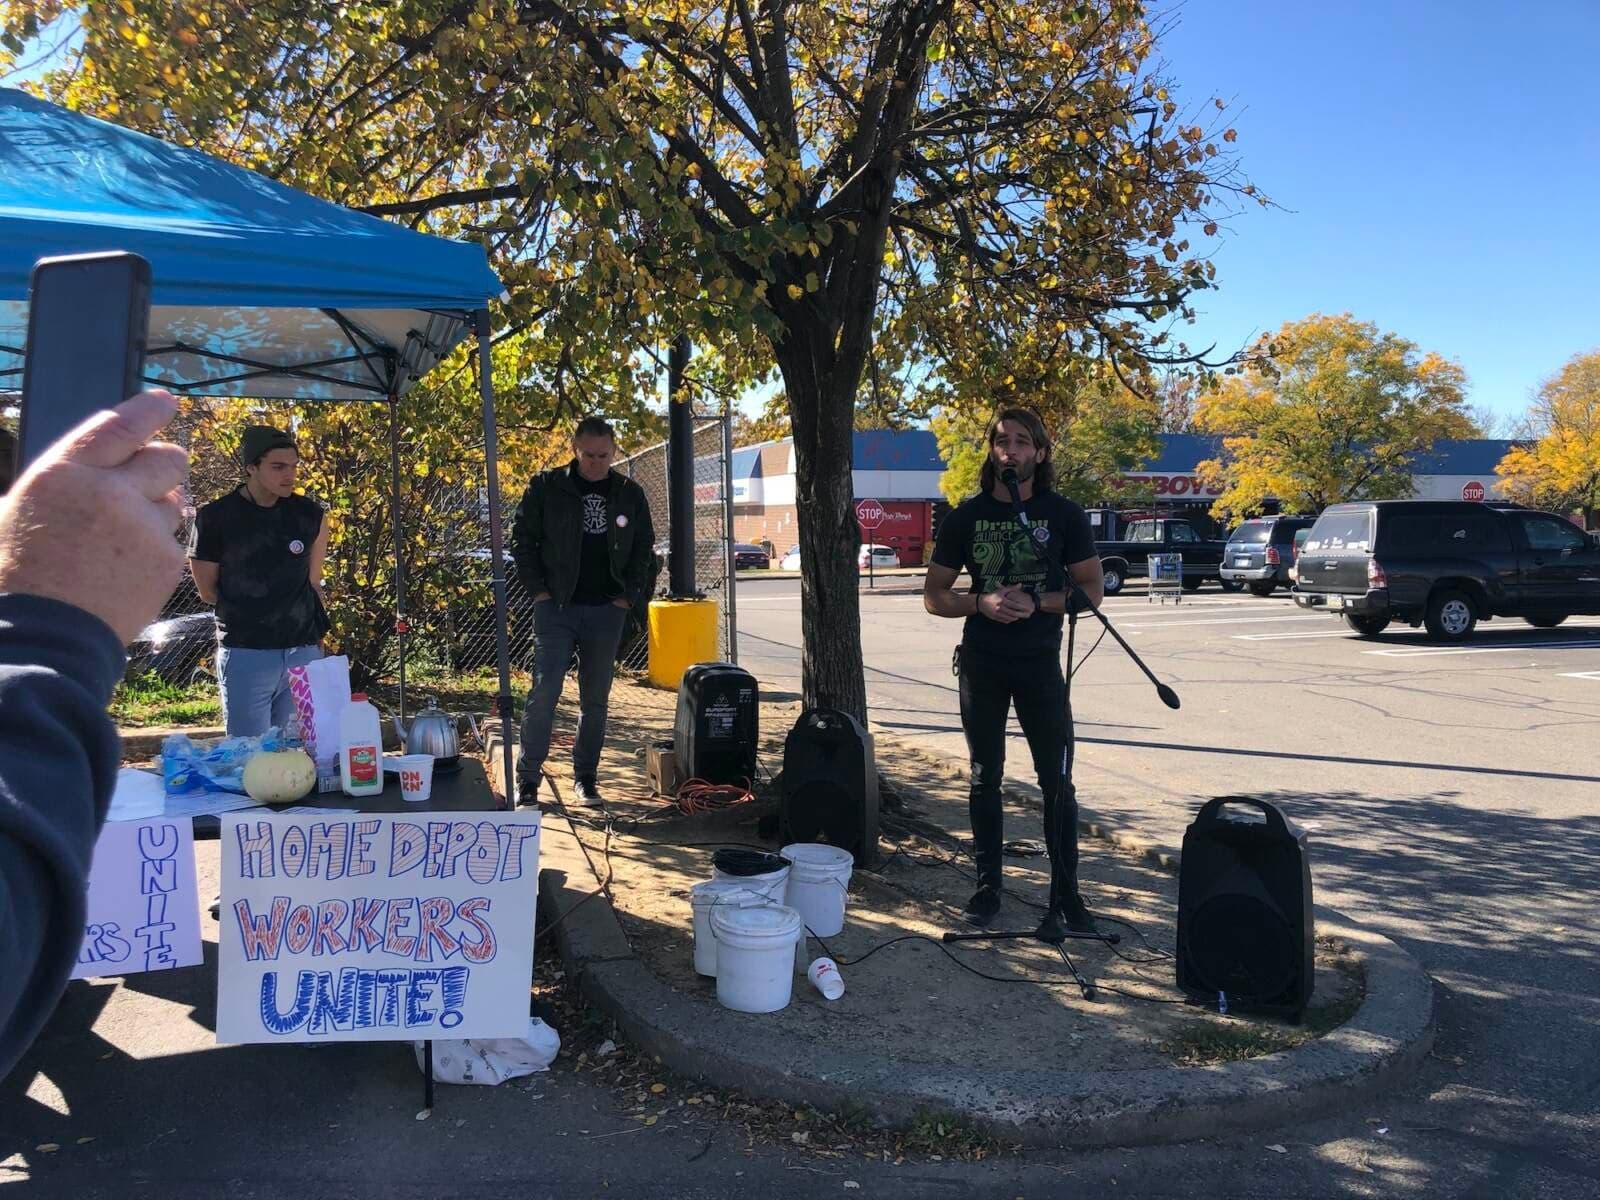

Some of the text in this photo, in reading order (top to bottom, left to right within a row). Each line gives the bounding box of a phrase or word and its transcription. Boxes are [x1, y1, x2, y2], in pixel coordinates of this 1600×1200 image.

[858, 507, 882, 520] STOP
[1463, 488, 1484, 500] STOP
[235, 819, 538, 885] HOME DEPOT
[134, 823, 180, 973] UNITE
[233, 896, 498, 965] WORKERS
[260, 965, 470, 1036] UNITE!
